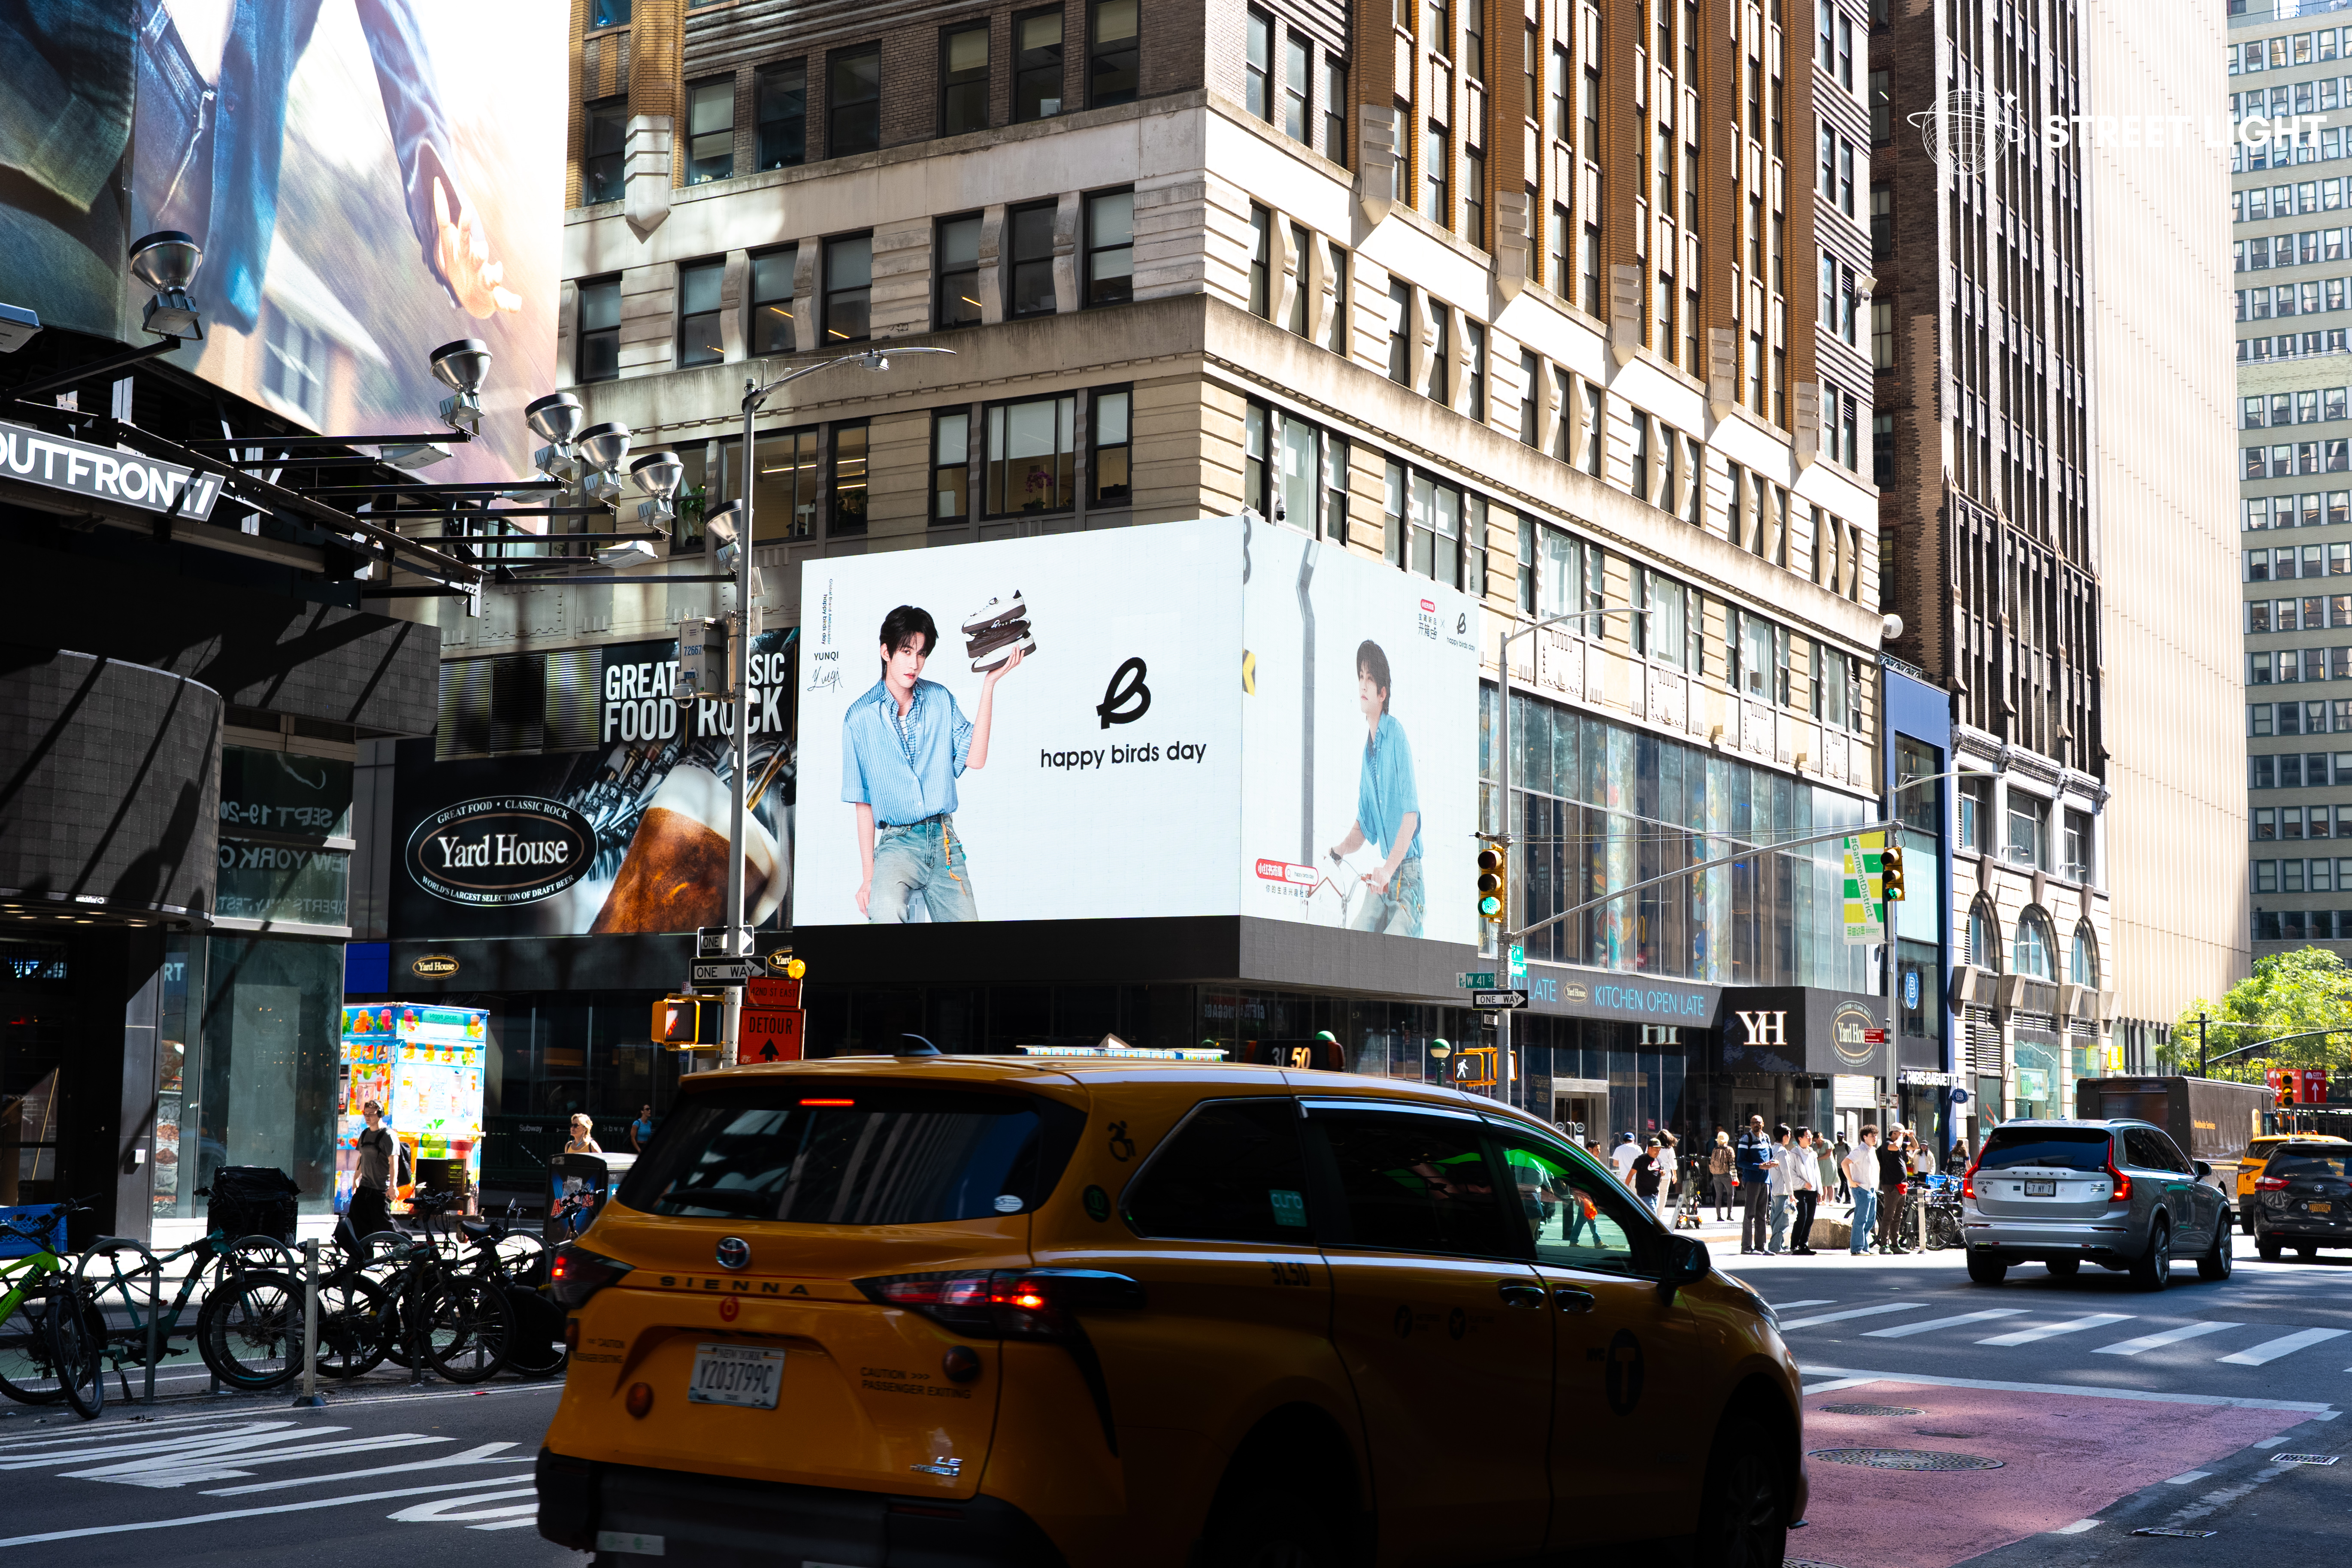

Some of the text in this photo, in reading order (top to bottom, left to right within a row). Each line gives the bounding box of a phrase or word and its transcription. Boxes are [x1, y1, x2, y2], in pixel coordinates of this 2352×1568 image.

[1447, 636, 1459, 647] happy
[1459, 639, 1468, 649] birds
[814, 651, 839, 661] YUNQI
[605, 660, 679, 700] GREAT
[604, 698, 677, 742] FOOD
[1041, 741, 1207, 770] happy birds day
[437, 800, 570, 824] GREAT FOOD CLASSIC ROCK
[438, 833, 569, 868] Yard House
[1258, 863, 1283, 878] 小红书市集
[1851, 838, 1874, 918] #GarmentDistrict
[422, 875, 574, 902] WORLD'S LARGEST SELECTION OF DRAFT BEER
[703, 936, 719, 948] ONE
[418, 962, 455, 971] Yard House
[696, 966, 755, 978] ONE WAY
[1467, 975, 1494, 986] W 41 St
[751, 987, 796, 998] 42ND ST EAST
[1566, 987, 1575, 996] Yard
[1575, 987, 1586, 997] House
[1595, 985, 1643, 1010] KITCHEN
[1647, 991, 1677, 1013] OPEN
[1680, 994, 1704, 1017] LATE
[749, 1016, 793, 1035] DETOUR
[1486, 1014, 1494, 1023] ONE
[1735, 1010, 1788, 1046] YH
[1837, 1022, 1865, 1044] Yard Hou
[1907, 1071, 1958, 1088] PARIS BAGUETTE
[519, 1124, 542, 1133] Subway
[2194, 1120, 2216, 1130] Worldwide Services
[1271, 1192, 1303, 1209] curb
[660, 1276, 810, 1296] SIENNA
[598, 1338, 625, 1349] CAUTION
[699, 1359, 773, 1394] Y203799C
[860, 1367, 906, 1380] CAUTION
[861, 1380, 972, 1399] PASSENGER EXITING
